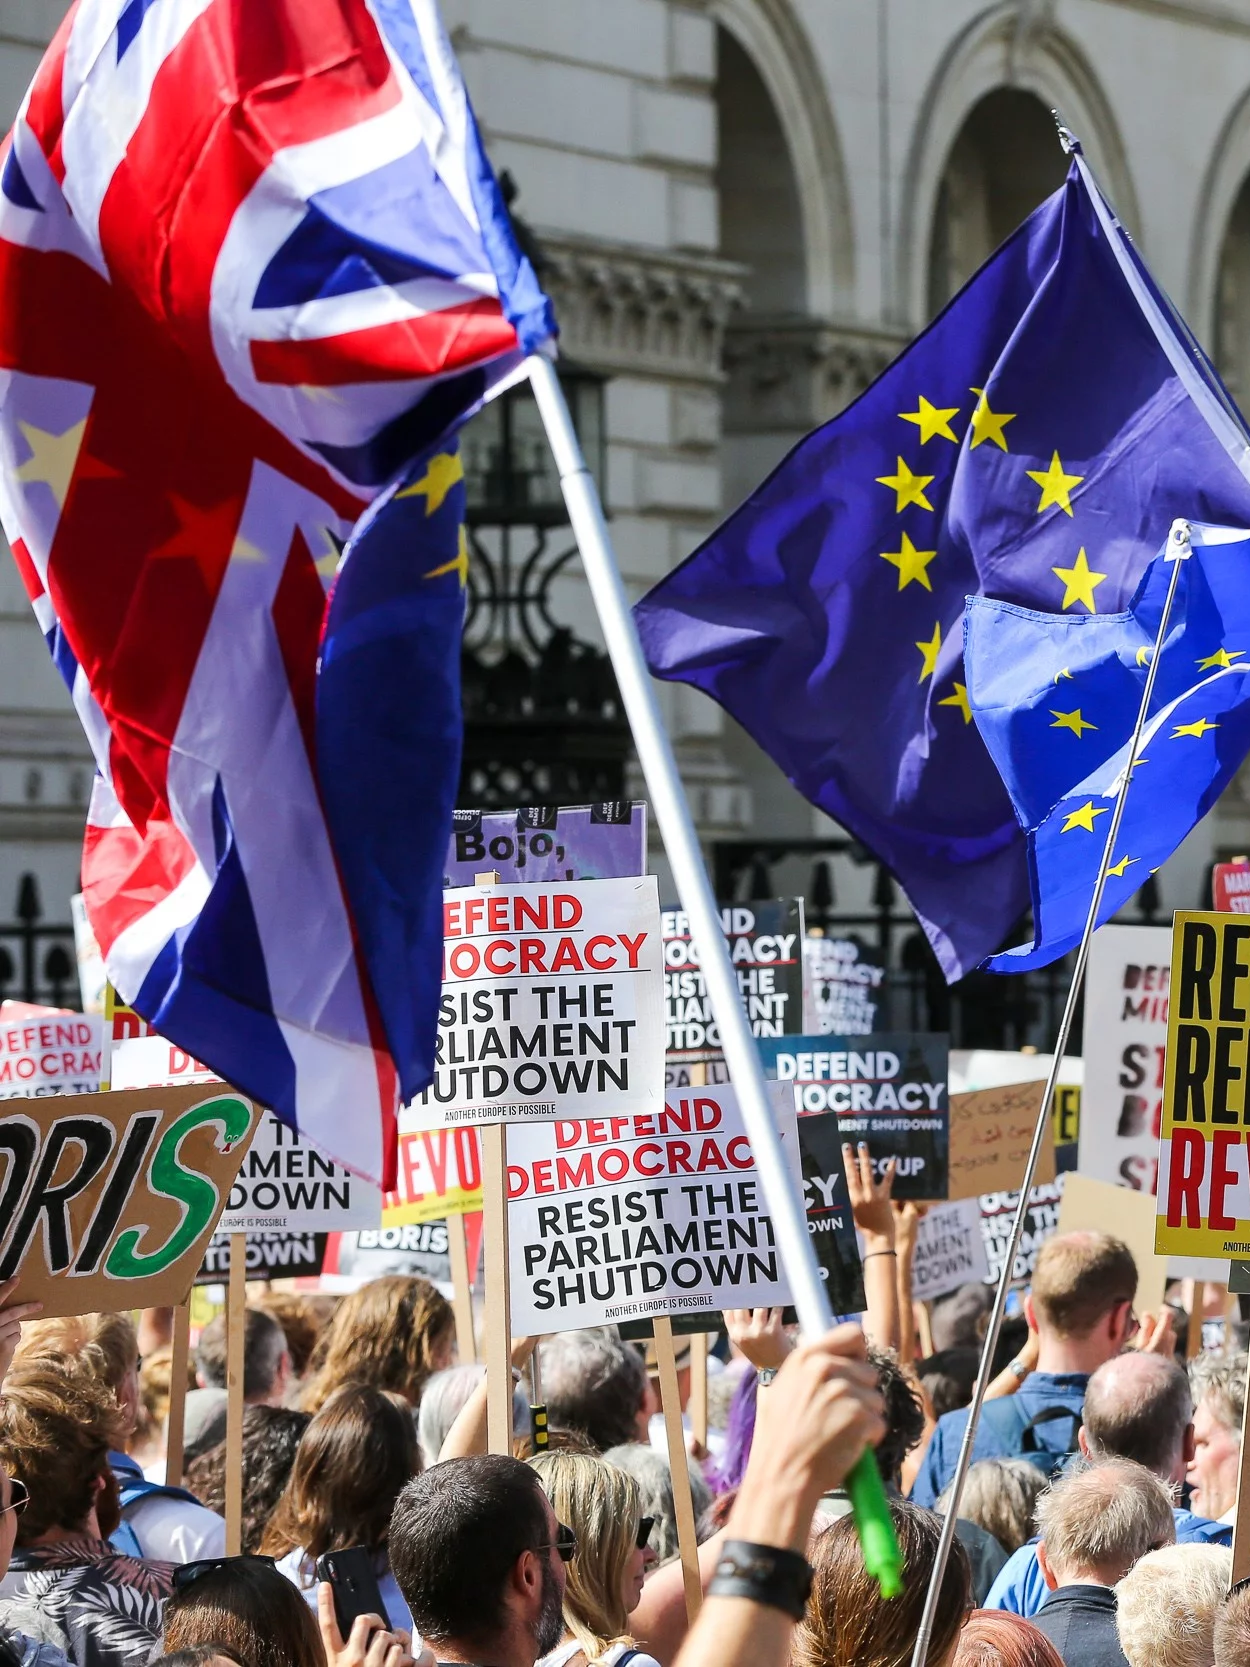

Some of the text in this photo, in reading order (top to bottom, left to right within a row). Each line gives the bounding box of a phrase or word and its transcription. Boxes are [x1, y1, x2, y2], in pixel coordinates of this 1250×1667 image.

[456, 820, 565, 868] Bojo,
[443, 895, 583, 938] EFEND
[443, 933, 649, 980] OCRACY
[437, 983, 614, 1028] SIST THE
[0, 1023, 91, 1052] EFEND
[433, 1020, 636, 1065] RLIAMENT
[421, 1057, 629, 1105] UTDOWN
[776, 1051, 900, 1080] DEFEND
[444, 1103, 557, 1122] ANOTHER EUROPE IS POSSIBLE
[796, 1082, 945, 1112] OCRACY
[0, 1092, 254, 1280] ORIS
[507, 1132, 785, 1198] DEMOCRAC
[247, 1218, 254, 1227] IS
[255, 1217, 287, 1227] POSSIBLE
[538, 1181, 759, 1238] RESIST THE
[932, 1208, 962, 1230] THE
[523, 1216, 776, 1277] PARLIAMENT
[533, 1251, 778, 1310] SHUTDOWN
[605, 1295, 714, 1319] ANOTHER EUROPE IS POSSIBLE
